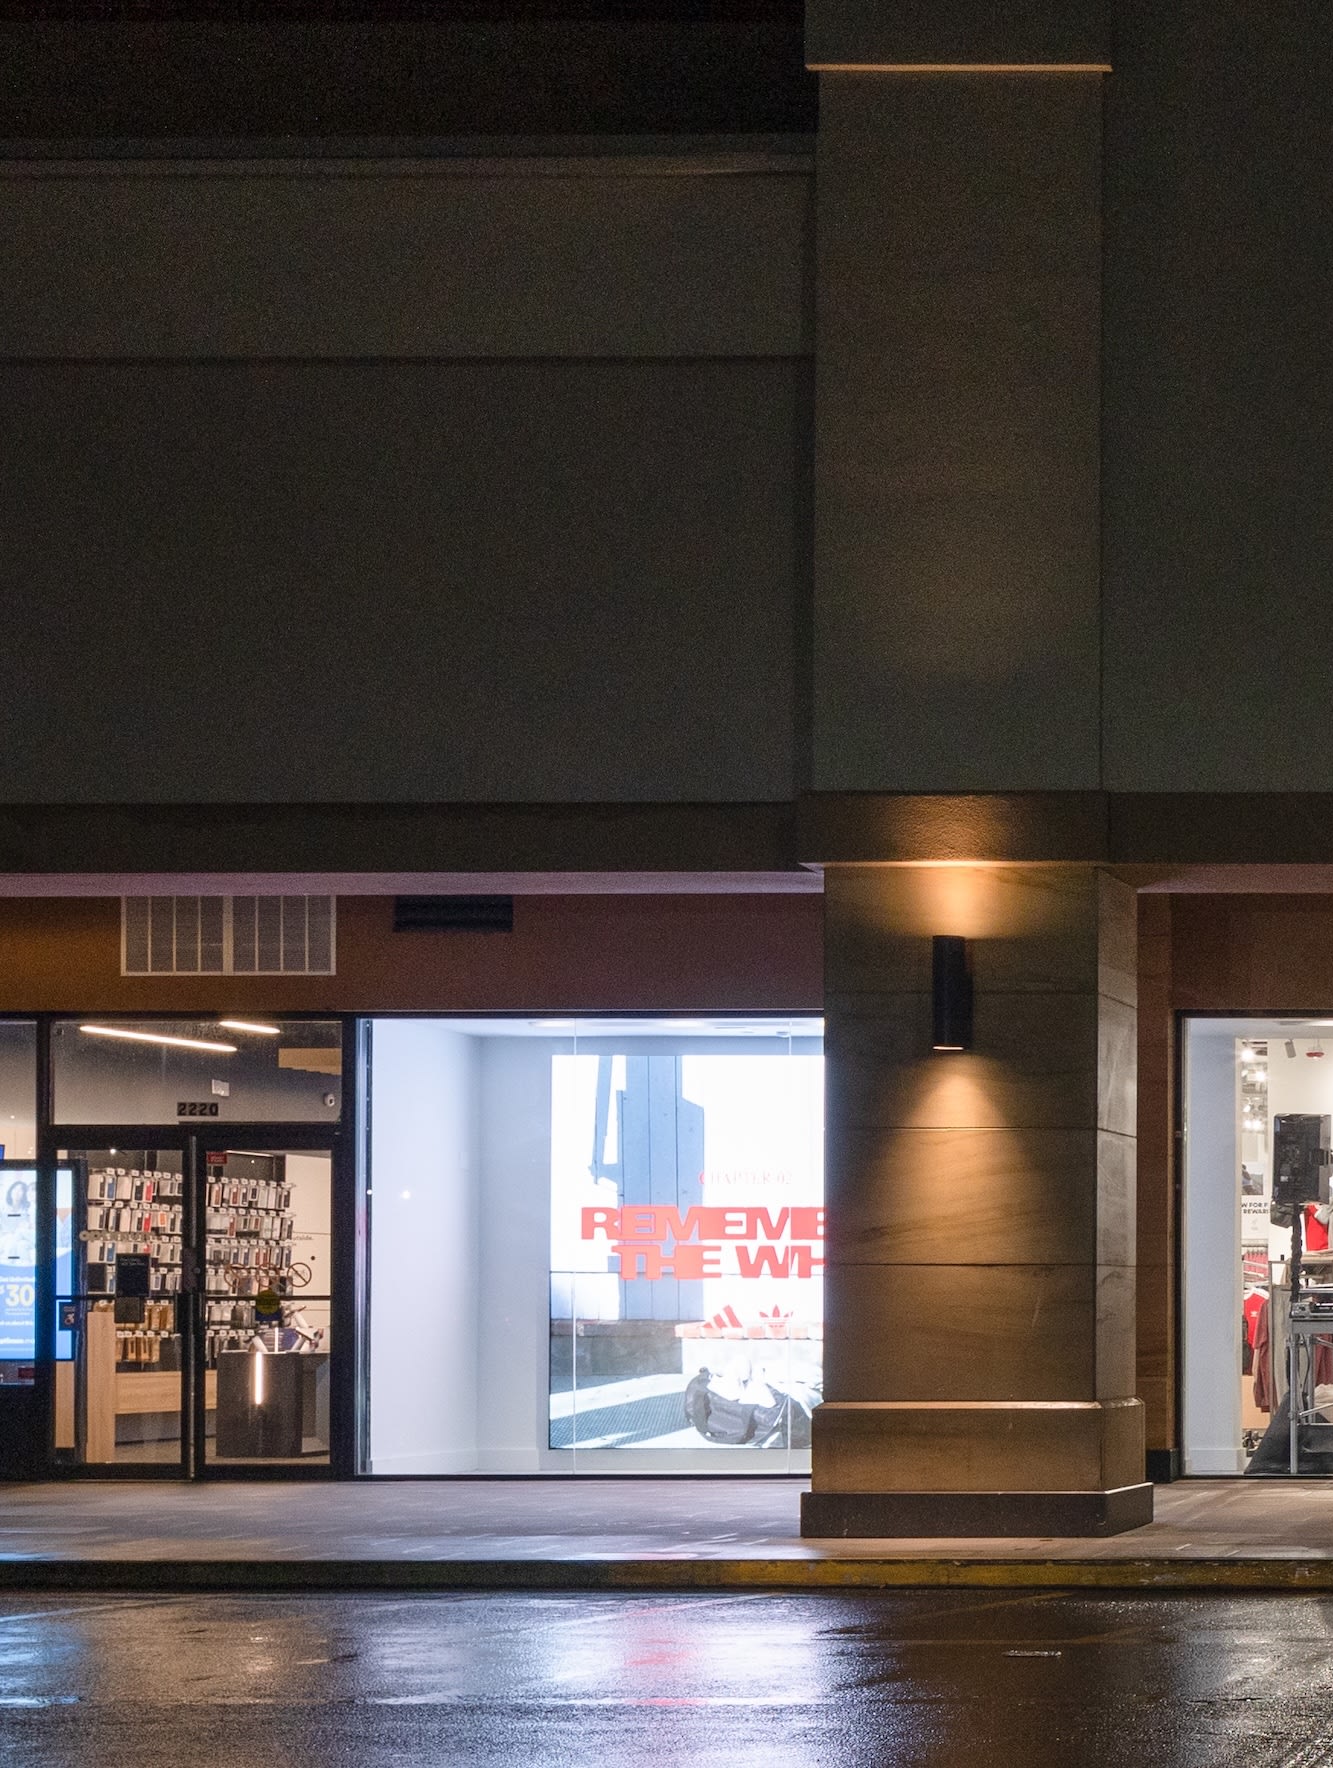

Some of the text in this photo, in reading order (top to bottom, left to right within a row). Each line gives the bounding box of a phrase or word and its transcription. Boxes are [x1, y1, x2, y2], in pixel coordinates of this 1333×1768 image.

[177, 1102, 219, 1117] 2220
[611, 1244, 828, 1280] THE WH
